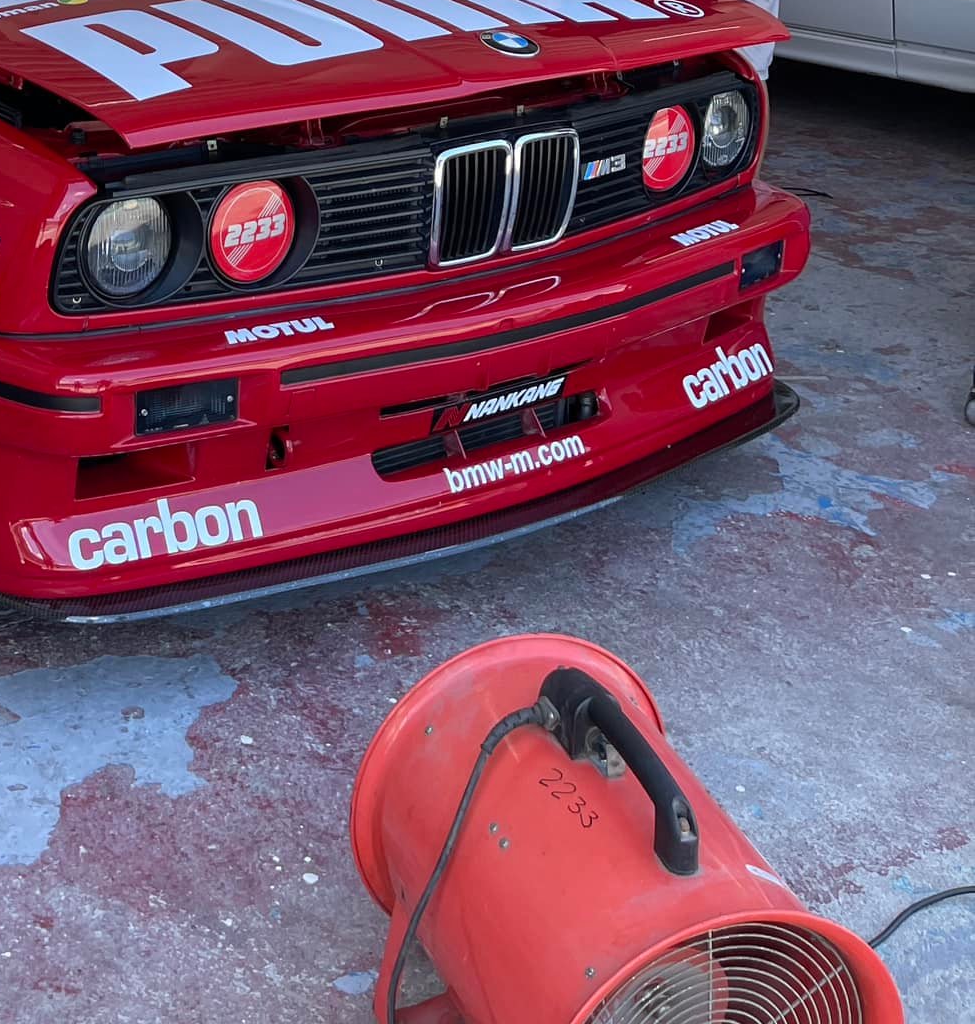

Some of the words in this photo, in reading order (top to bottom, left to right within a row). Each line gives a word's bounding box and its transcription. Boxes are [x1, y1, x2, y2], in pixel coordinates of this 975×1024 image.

[642, 132, 688, 158] 2233
[225, 215, 285, 247] 2233
[670, 220, 739, 247] MOTUL
[224, 317, 335, 345] MOTUL
[463, 376, 565, 422] NANKANG
[682, 343, 773, 409] carbon
[443, 434, 585, 493] bmw-m.com
[68, 498, 263, 570] carbon
[538, 768, 599, 829] 2233
